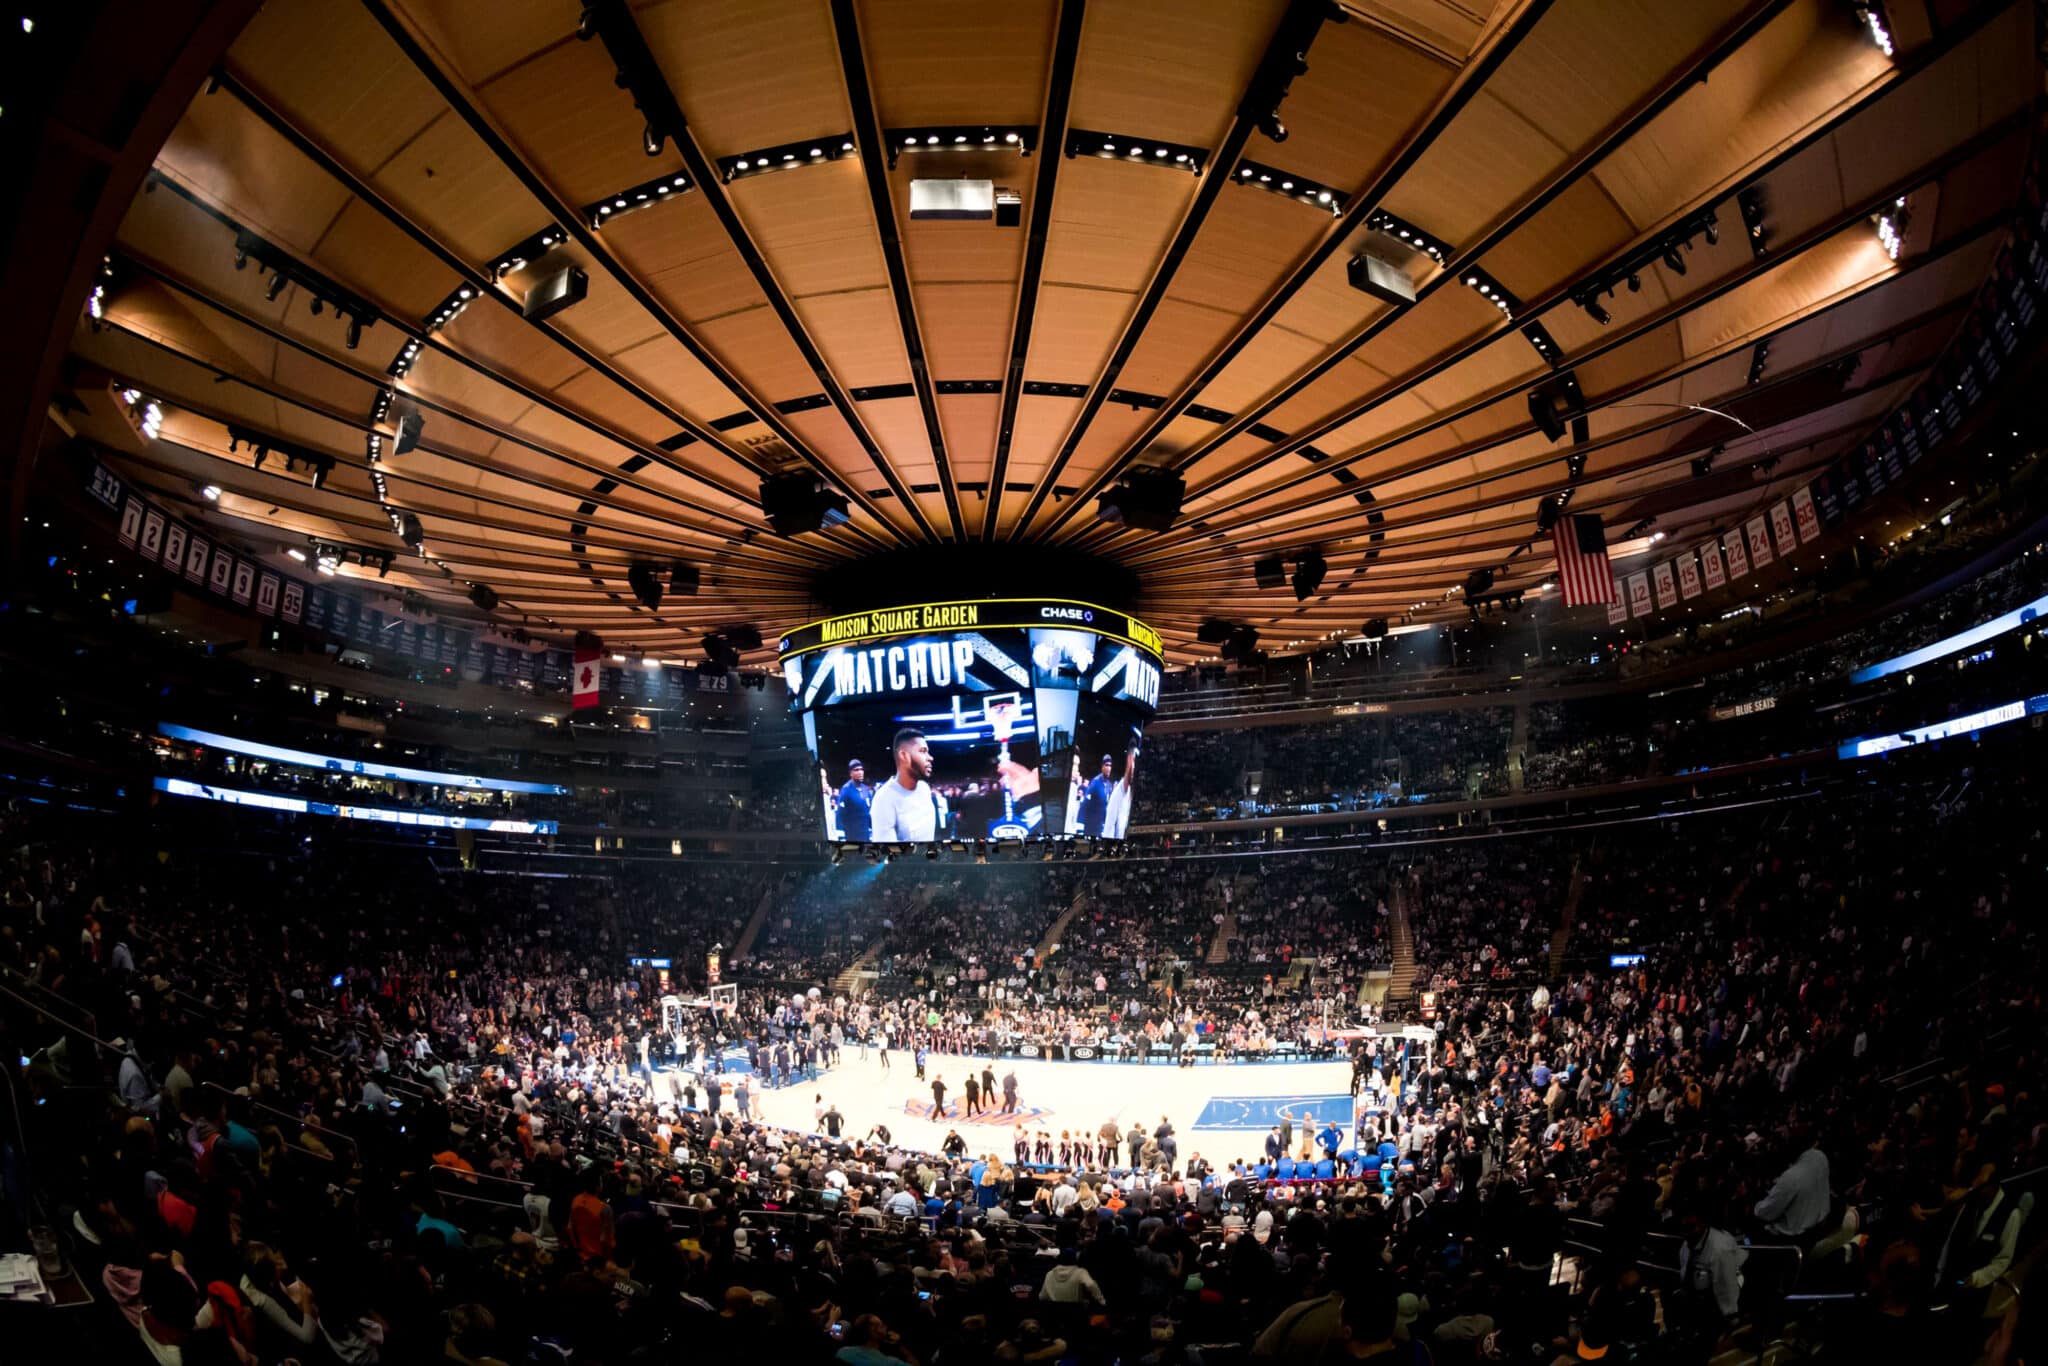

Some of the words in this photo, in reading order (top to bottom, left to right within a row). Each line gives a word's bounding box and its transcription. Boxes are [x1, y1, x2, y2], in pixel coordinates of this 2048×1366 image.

[102, 473, 120, 504] 33
[127, 513, 135, 534] 1
[1797, 501, 1815, 527] 613
[147, 525, 157, 547] 2
[1776, 517, 1790, 539] 33
[170, 539, 180, 565] 3
[1751, 530, 1768, 553] 24
[194, 551, 203, 572] 7
[1705, 554, 1720, 574] 19
[1728, 543, 1744, 564] 22
[217, 563, 226, 583] 9
[1682, 565, 1695, 585] 15
[239, 574, 248, 594] 9
[1633, 585, 1647, 602] 12
[1659, 575, 1671, 594] 15
[262, 585, 275, 606] 11
[285, 593, 301, 614] 35
[821, 616, 869, 642] MADISON
[871, 609, 920, 635] SQUARE
[922, 604, 978, 628] GARDEN
[1041, 606, 1083, 620] CHASE
[834, 640, 975, 697] MATCHUP
[711, 674, 728, 690] 79
[1735, 702, 1754, 717] BLUE
[1754, 696, 1776, 711] SEATS
